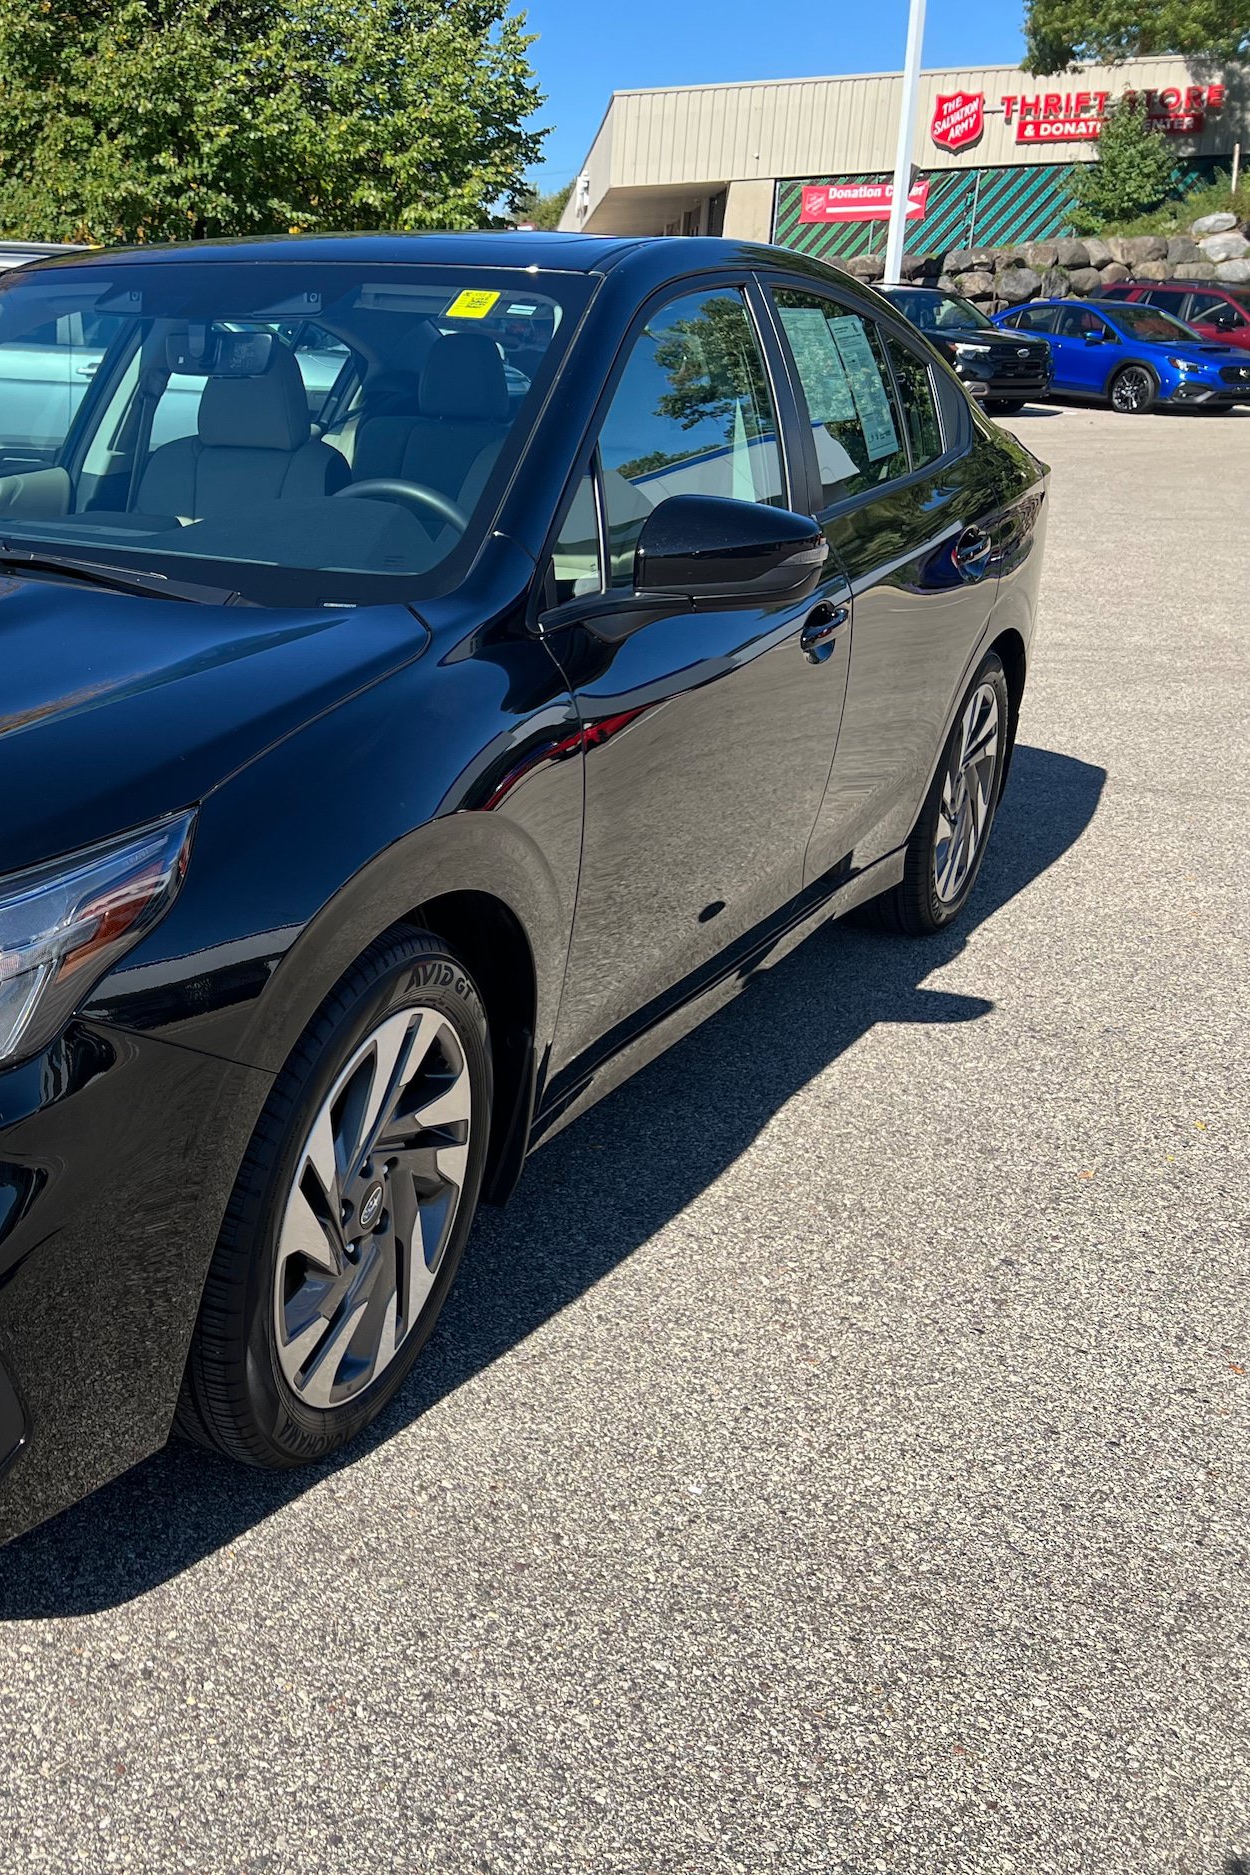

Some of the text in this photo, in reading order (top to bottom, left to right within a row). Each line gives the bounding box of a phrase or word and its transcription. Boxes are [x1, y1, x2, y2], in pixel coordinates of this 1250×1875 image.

[934, 97, 980, 136] SALVATION
[942, 96, 963, 114] THE
[1002, 92, 1108, 116] THRIFT
[947, 114, 977, 142] ARMY
[1023, 116, 1195, 137] & DONATI ENTER
[828, 185, 925, 199] Donation Cer
[404, 963, 474, 1001] AVID GT
[278, 1417, 349, 1456] YOKOHAMA
